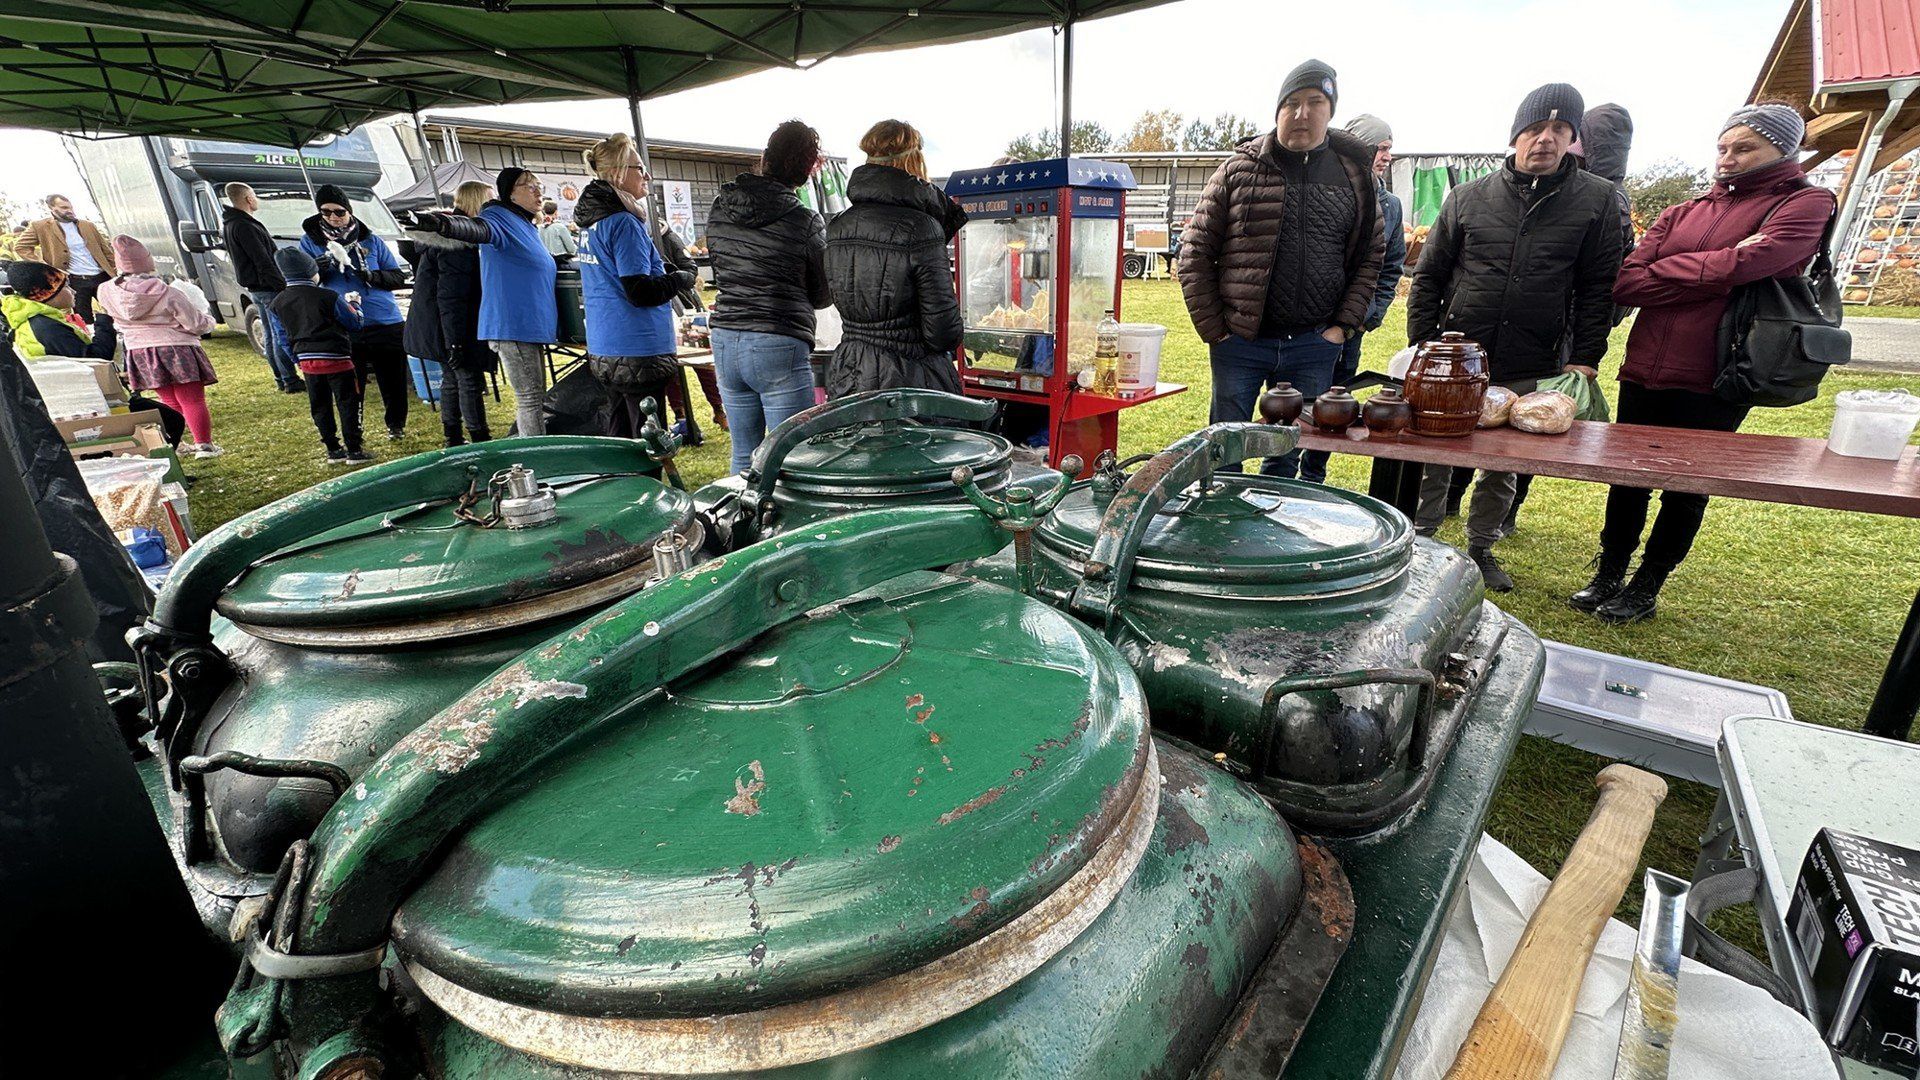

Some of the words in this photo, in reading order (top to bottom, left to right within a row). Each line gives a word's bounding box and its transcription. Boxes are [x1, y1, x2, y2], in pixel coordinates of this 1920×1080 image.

[266, 154, 285, 164] LCL
[1841, 850, 1892, 871] PRO
[1845, 860, 1894, 880] Grip
[1839, 904, 1855, 932] TECH
[1862, 880, 1920, 946] TECH
[1834, 914, 1847, 939] LINE
